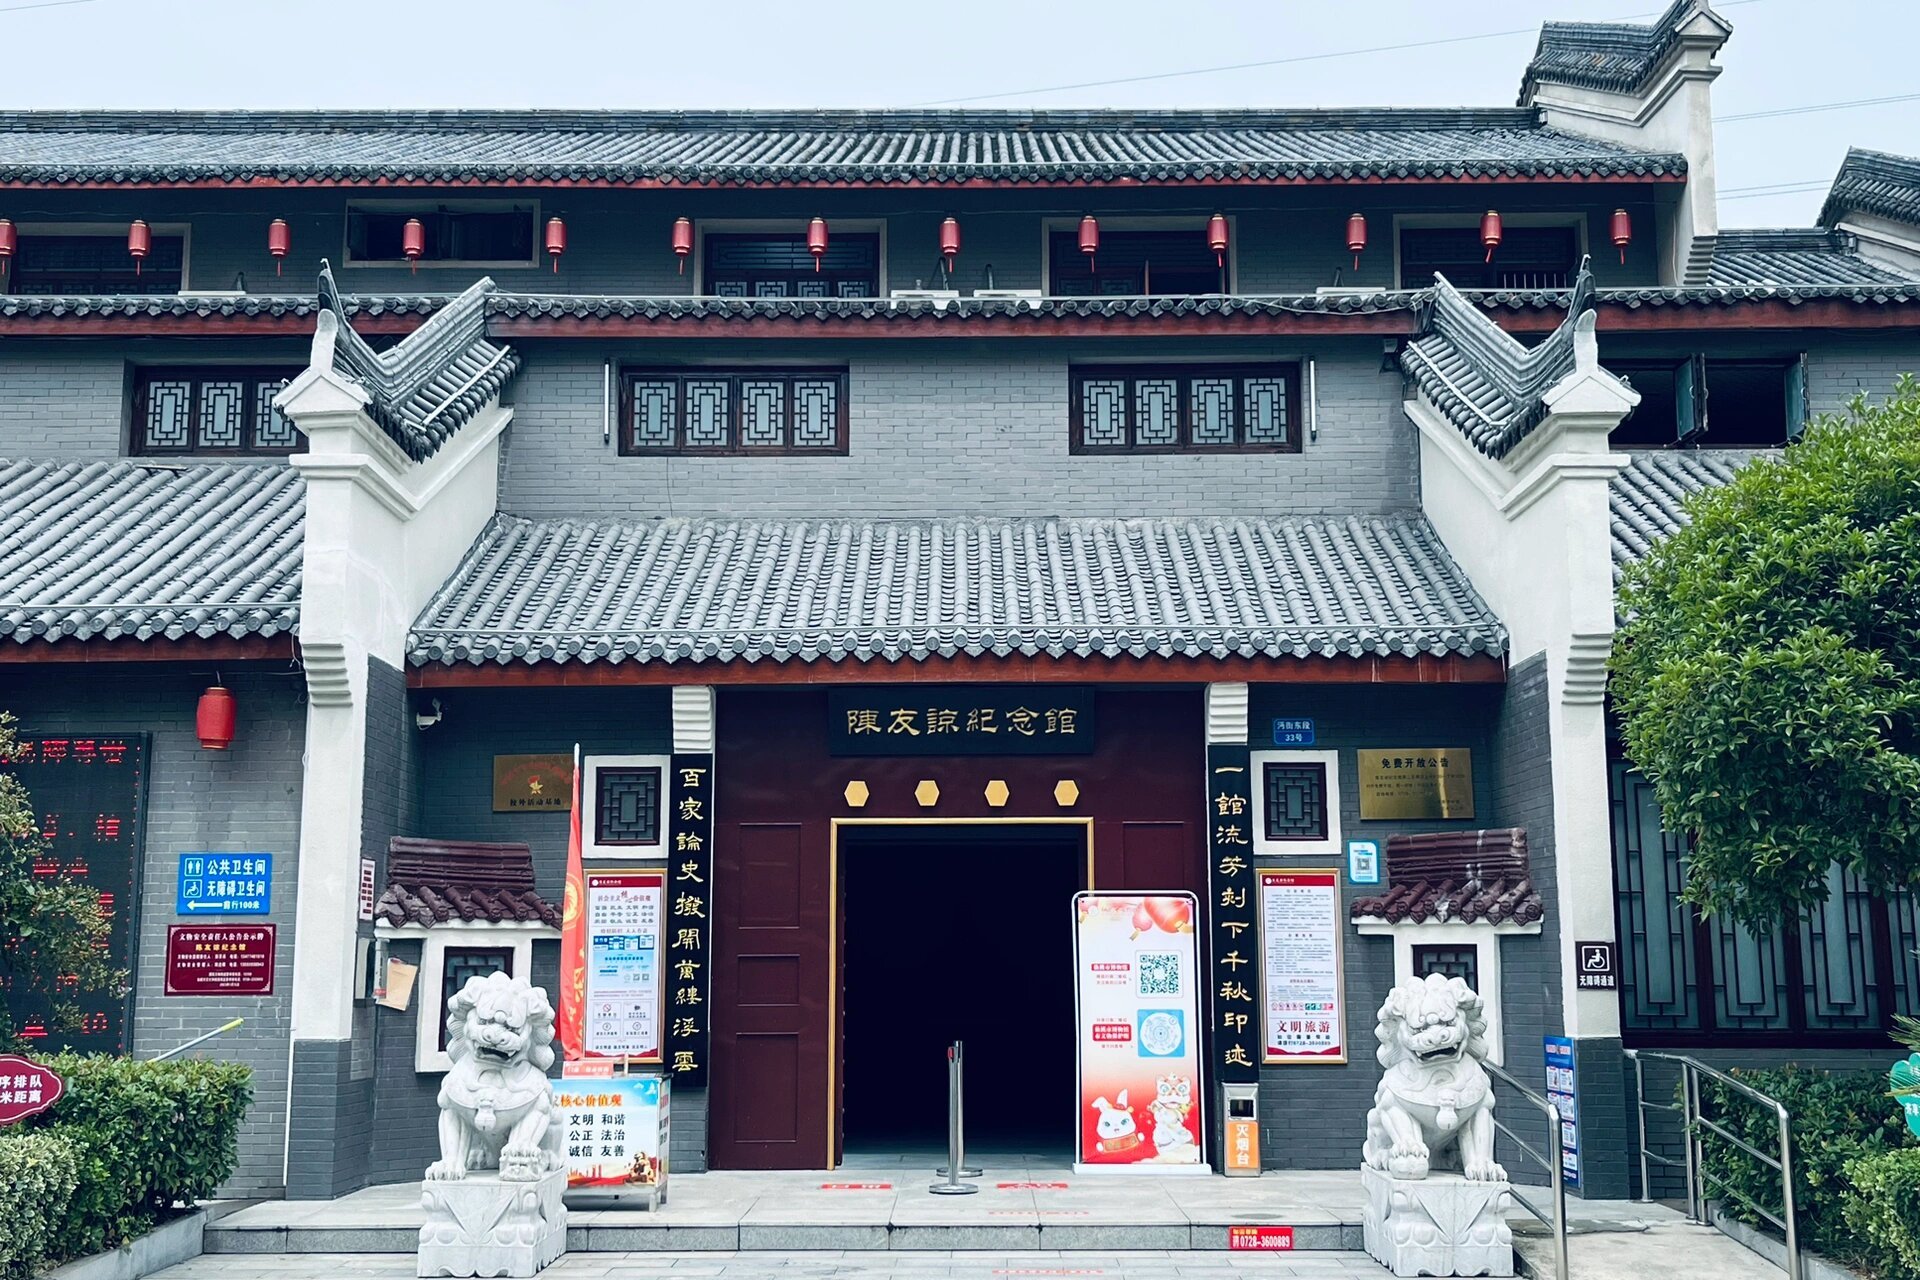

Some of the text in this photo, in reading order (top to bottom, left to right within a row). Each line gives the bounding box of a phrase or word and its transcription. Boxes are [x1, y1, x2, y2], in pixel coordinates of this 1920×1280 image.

[1285, 733, 1303, 742] 33号
[1381, 757, 1450, 769] 免费开放公告
[207, 859, 266, 876] 公共卫生间
[206, 880, 265, 897] 无障碍卫生间
[1276, 1020, 1330, 1033] 文明旅游
[569, 1114, 626, 1126] 文明 和谐
[568, 1129, 626, 1142] 公正 法治
[568, 1145, 625, 1158] 诚信 友善
[1236, 1124, 1250, 1166] 灭烟台
